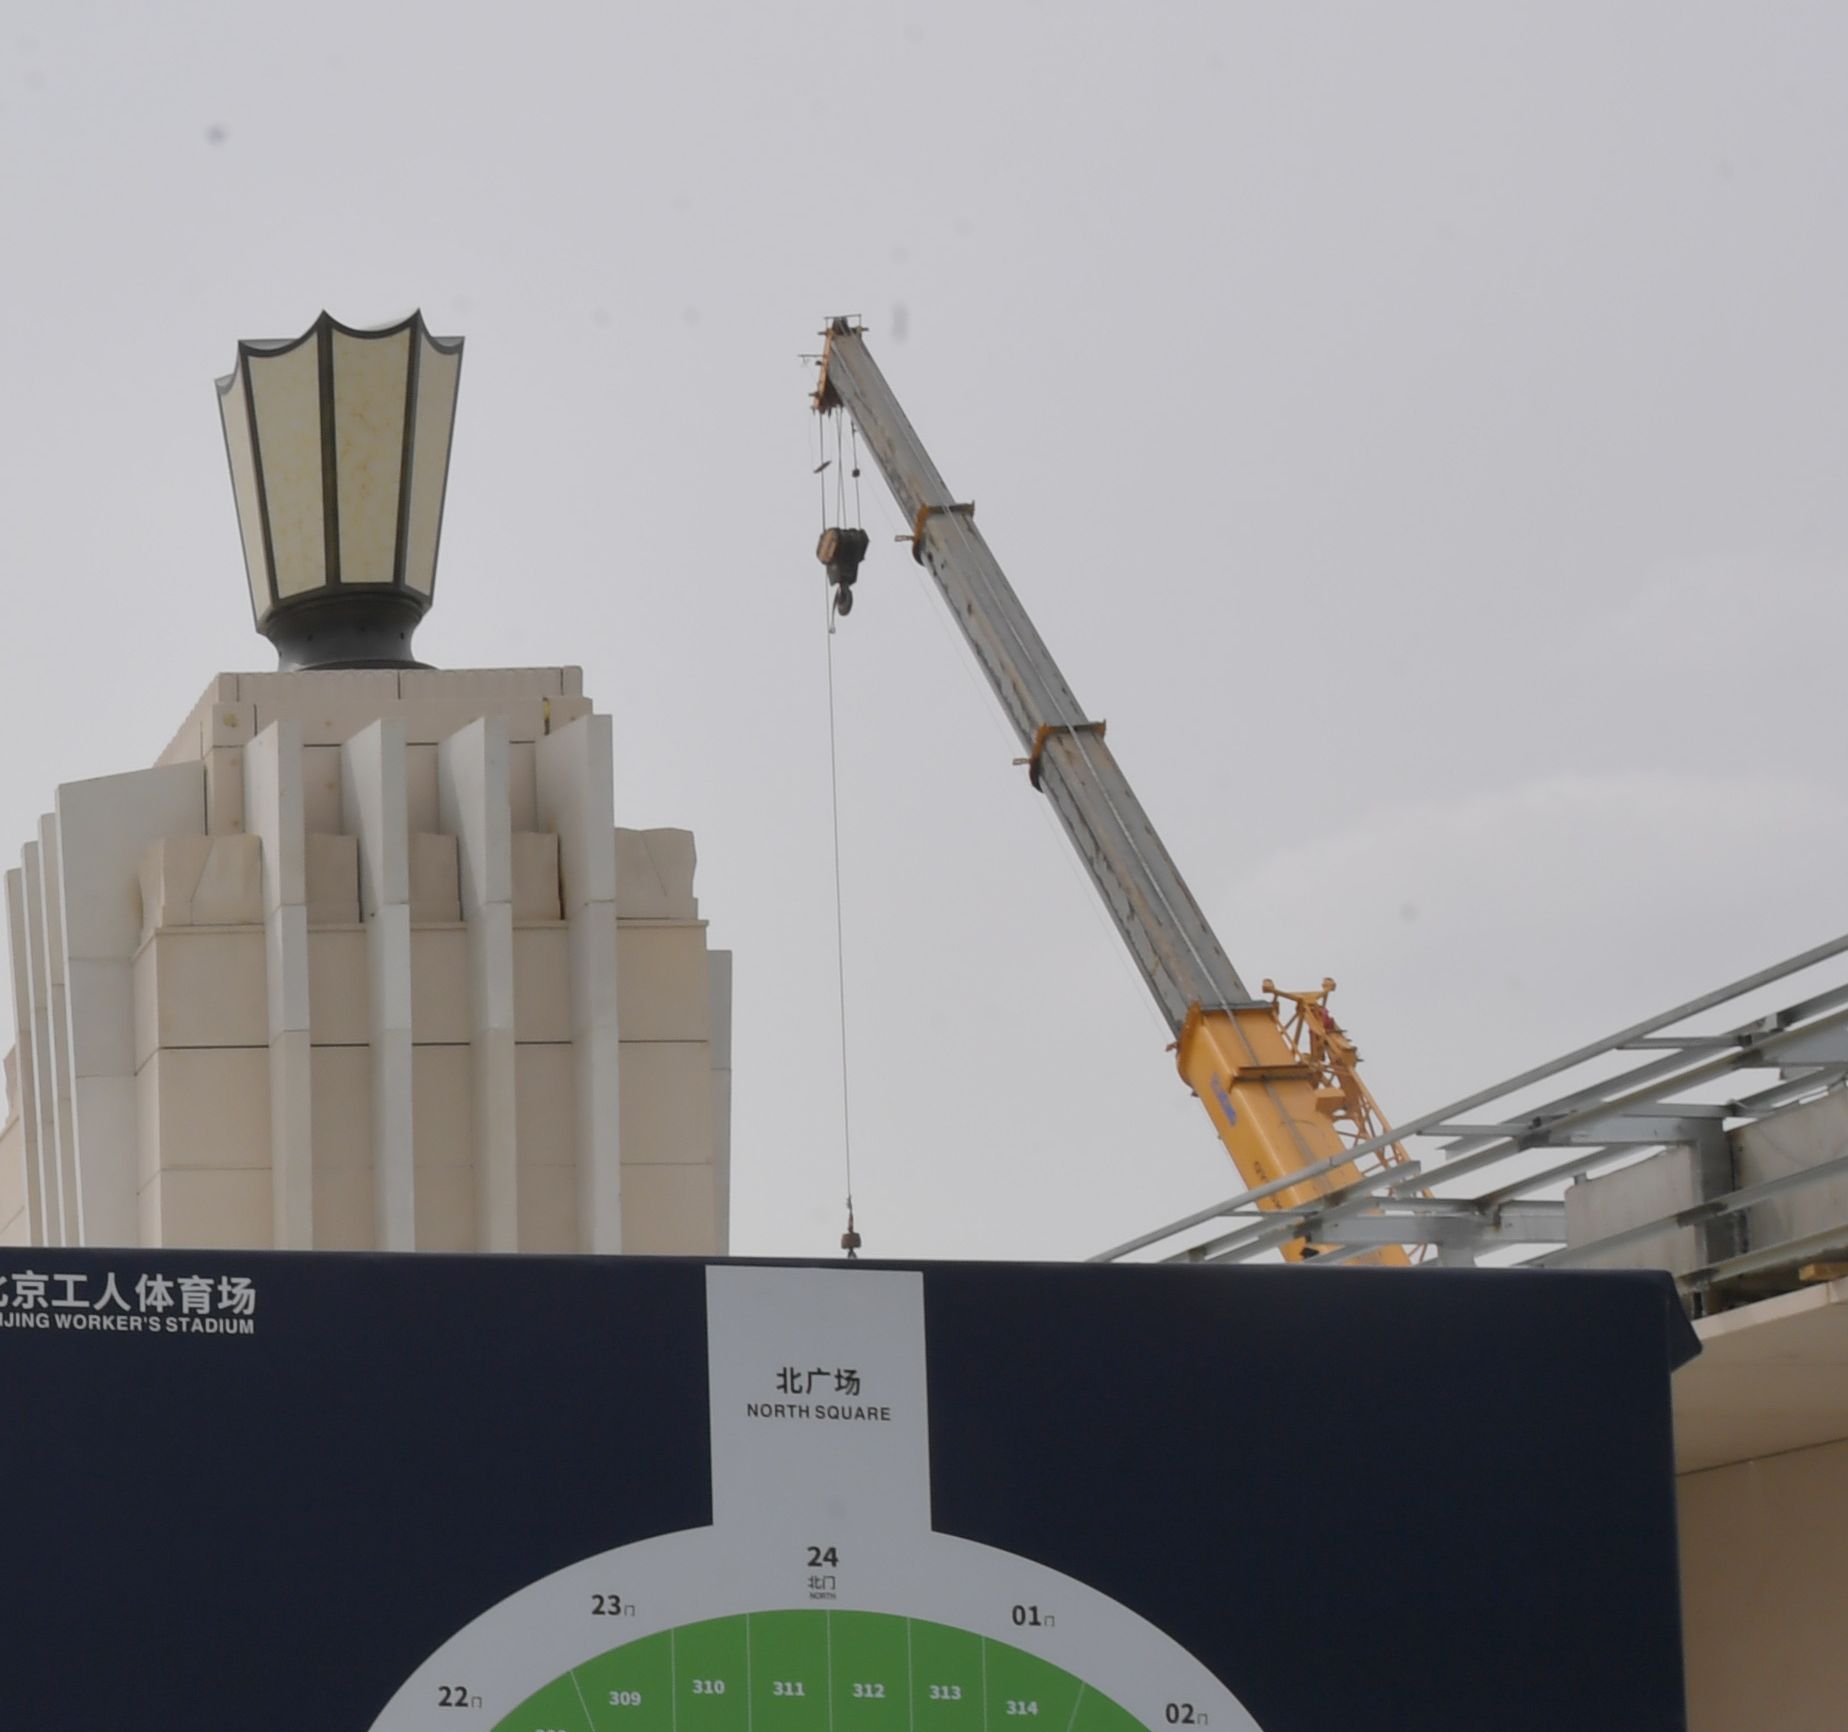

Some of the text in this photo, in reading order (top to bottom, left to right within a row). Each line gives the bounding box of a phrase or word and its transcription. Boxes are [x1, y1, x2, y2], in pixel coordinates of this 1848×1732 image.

[55, 1314, 161, 1332] WORKER'S
[166, 1316, 254, 1334] STADIUM
[775, 1365, 862, 1397] 北广场
[746, 1402, 892, 1422] NORTH SQUARE
[806, 1545, 840, 1569] 24
[807, 1574, 837, 1590] 北门
[773, 1680, 805, 1697] 311
[929, 1684, 962, 1700] 313
[609, 1690, 642, 1706] 309
